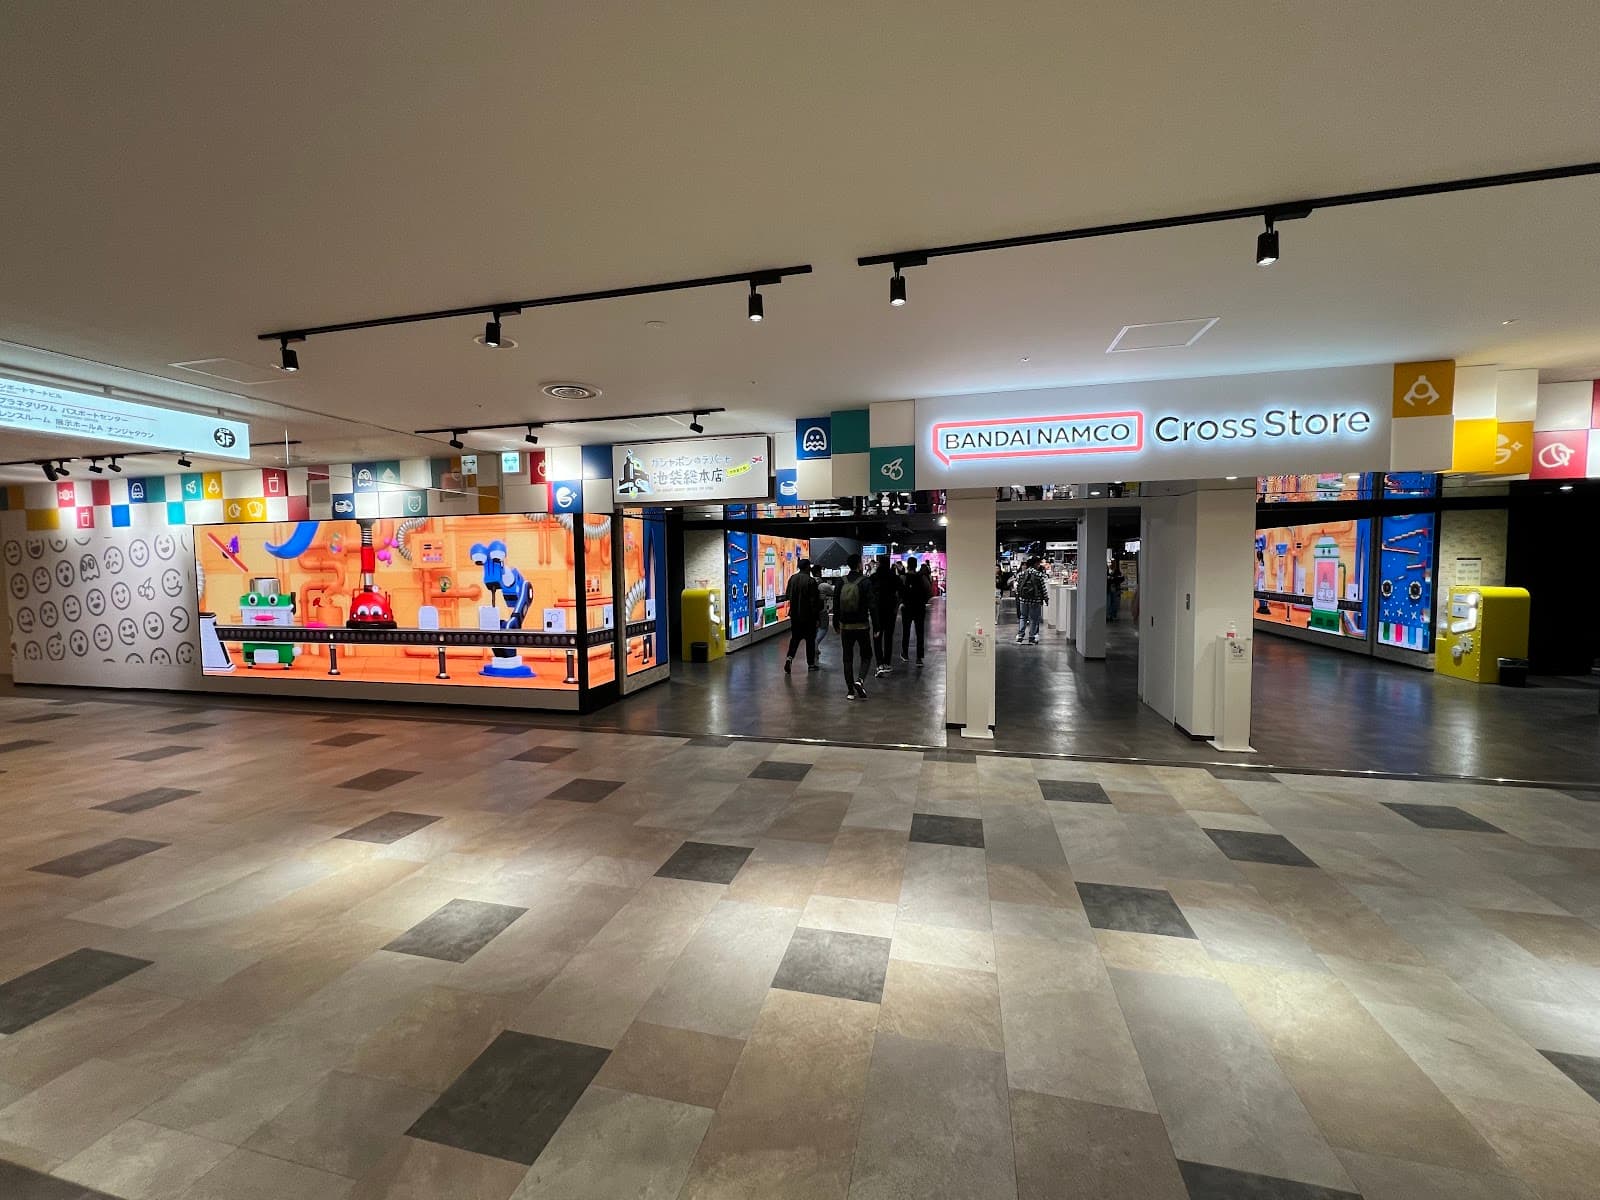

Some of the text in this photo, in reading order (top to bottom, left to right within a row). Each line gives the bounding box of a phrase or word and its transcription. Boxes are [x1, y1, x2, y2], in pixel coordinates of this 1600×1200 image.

[946, 410, 1370, 449] BANDAI NAMCO Cross Store
[216, 431, 233, 447] 3F
[653, 467, 723, 485] 池袋総本店
